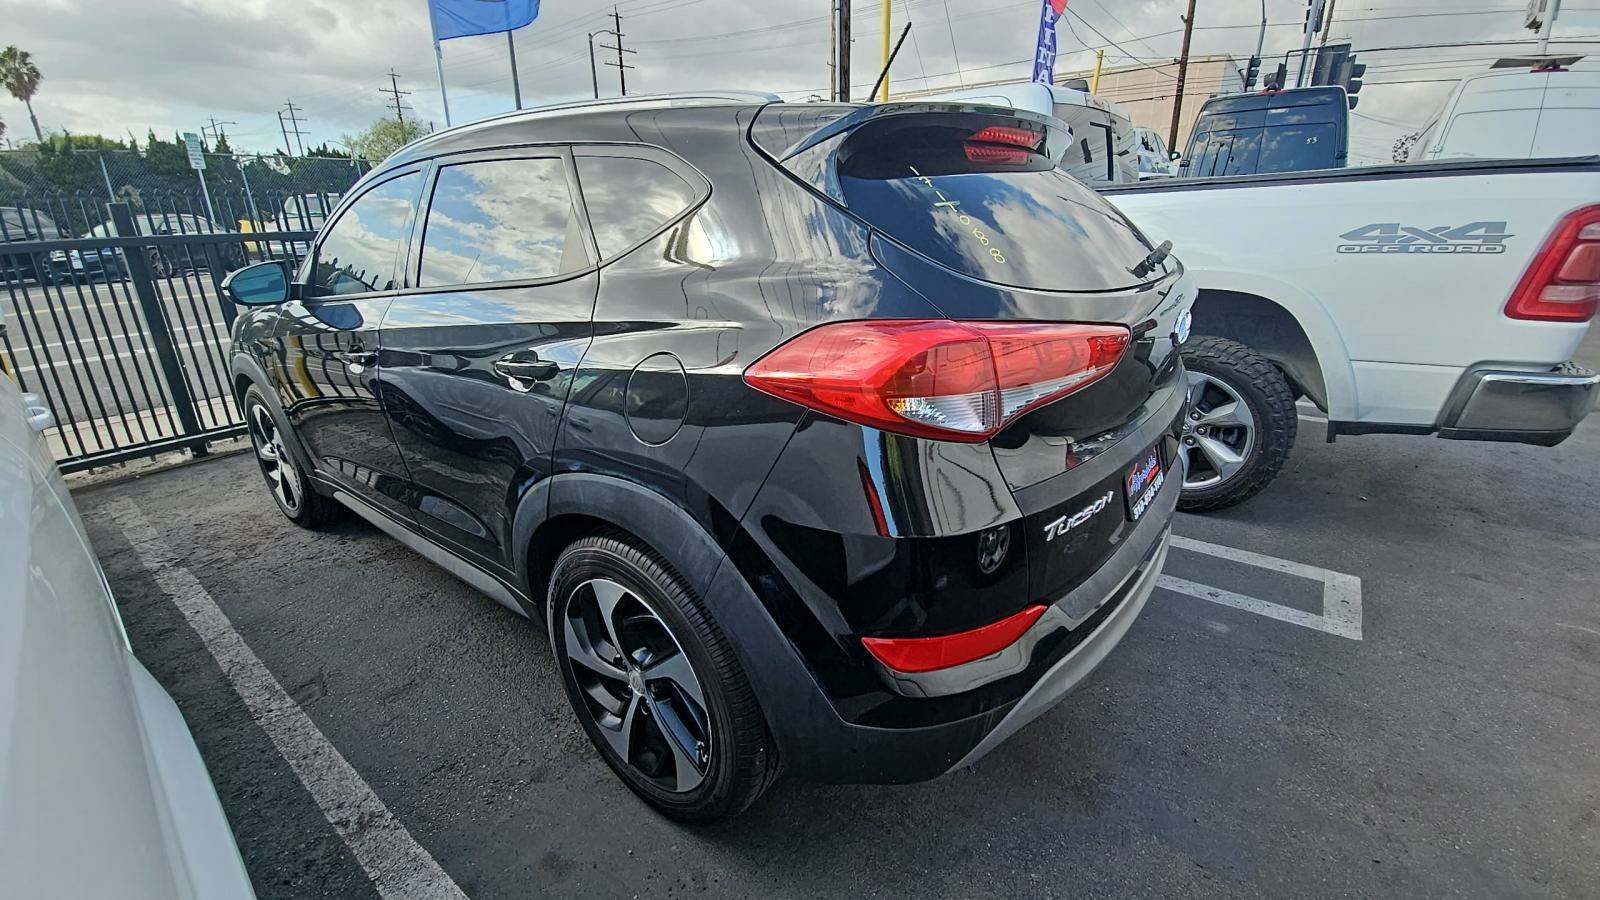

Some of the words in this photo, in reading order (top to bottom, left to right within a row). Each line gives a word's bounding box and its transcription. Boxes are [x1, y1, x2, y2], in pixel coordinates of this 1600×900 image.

[1339, 244, 1401, 253] OFF
[1407, 244, 1505, 253] ROAD
[1044, 490, 1114, 541] TUCSON
